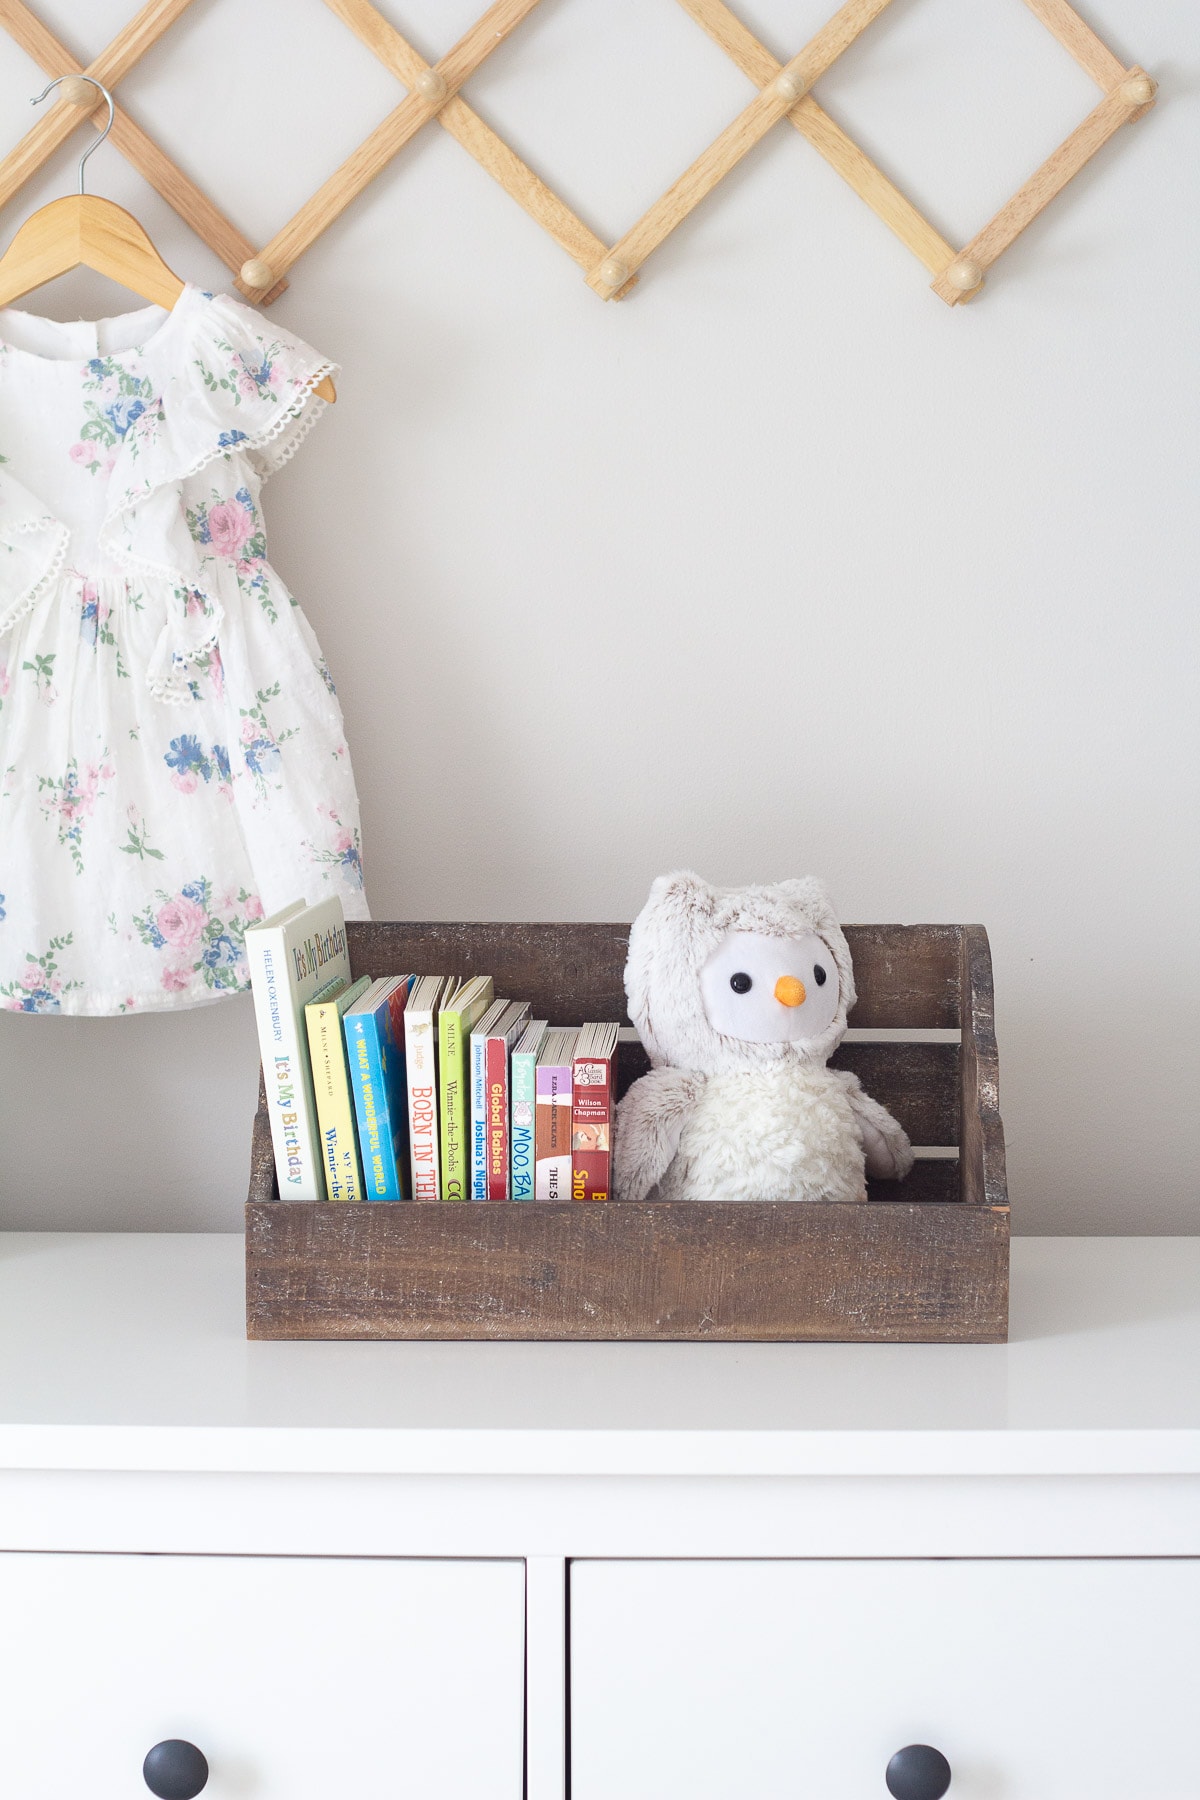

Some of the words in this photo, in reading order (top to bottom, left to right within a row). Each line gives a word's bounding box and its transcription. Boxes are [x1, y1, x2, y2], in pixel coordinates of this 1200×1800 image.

[263, 949, 275, 984] HELEN
[293, 948, 307, 981] It's
[304, 939, 318, 980] My
[314, 925, 346, 967] Birthday
[268, 986, 282, 1042] OXENBURY
[274, 1056, 291, 1081] It's
[355, 1039, 371, 1070] WHAT
[414, 1043, 424, 1070] Judge
[360, 1073, 371, 1081] A
[474, 1045, 482, 1109] Johnson/Mitchell
[277, 1084, 295, 1108] My
[411, 1086, 433, 1136] BORN
[491, 1083, 503, 1126] Global
[574, 1109, 606, 1117] Chapman
[362, 1084, 381, 1153] WONDERFUL
[446, 1080, 458, 1172] Winnie-the-Pooh's
[281, 1112, 304, 1185] Birthday
[343, 1152, 352, 1168] MY
[414, 1143, 433, 1163] IN
[475, 1120, 485, 1166] Joshua's
[491, 1130, 503, 1175] Babies
[513, 1127, 532, 1170] MOO,
[372, 1155, 387, 1195] WORLD
[473, 1170, 486, 1199] Night
[513, 1171, 532, 1200] BA
[549, 1167, 558, 1189] THE
[573, 1170, 588, 1200] Sno
